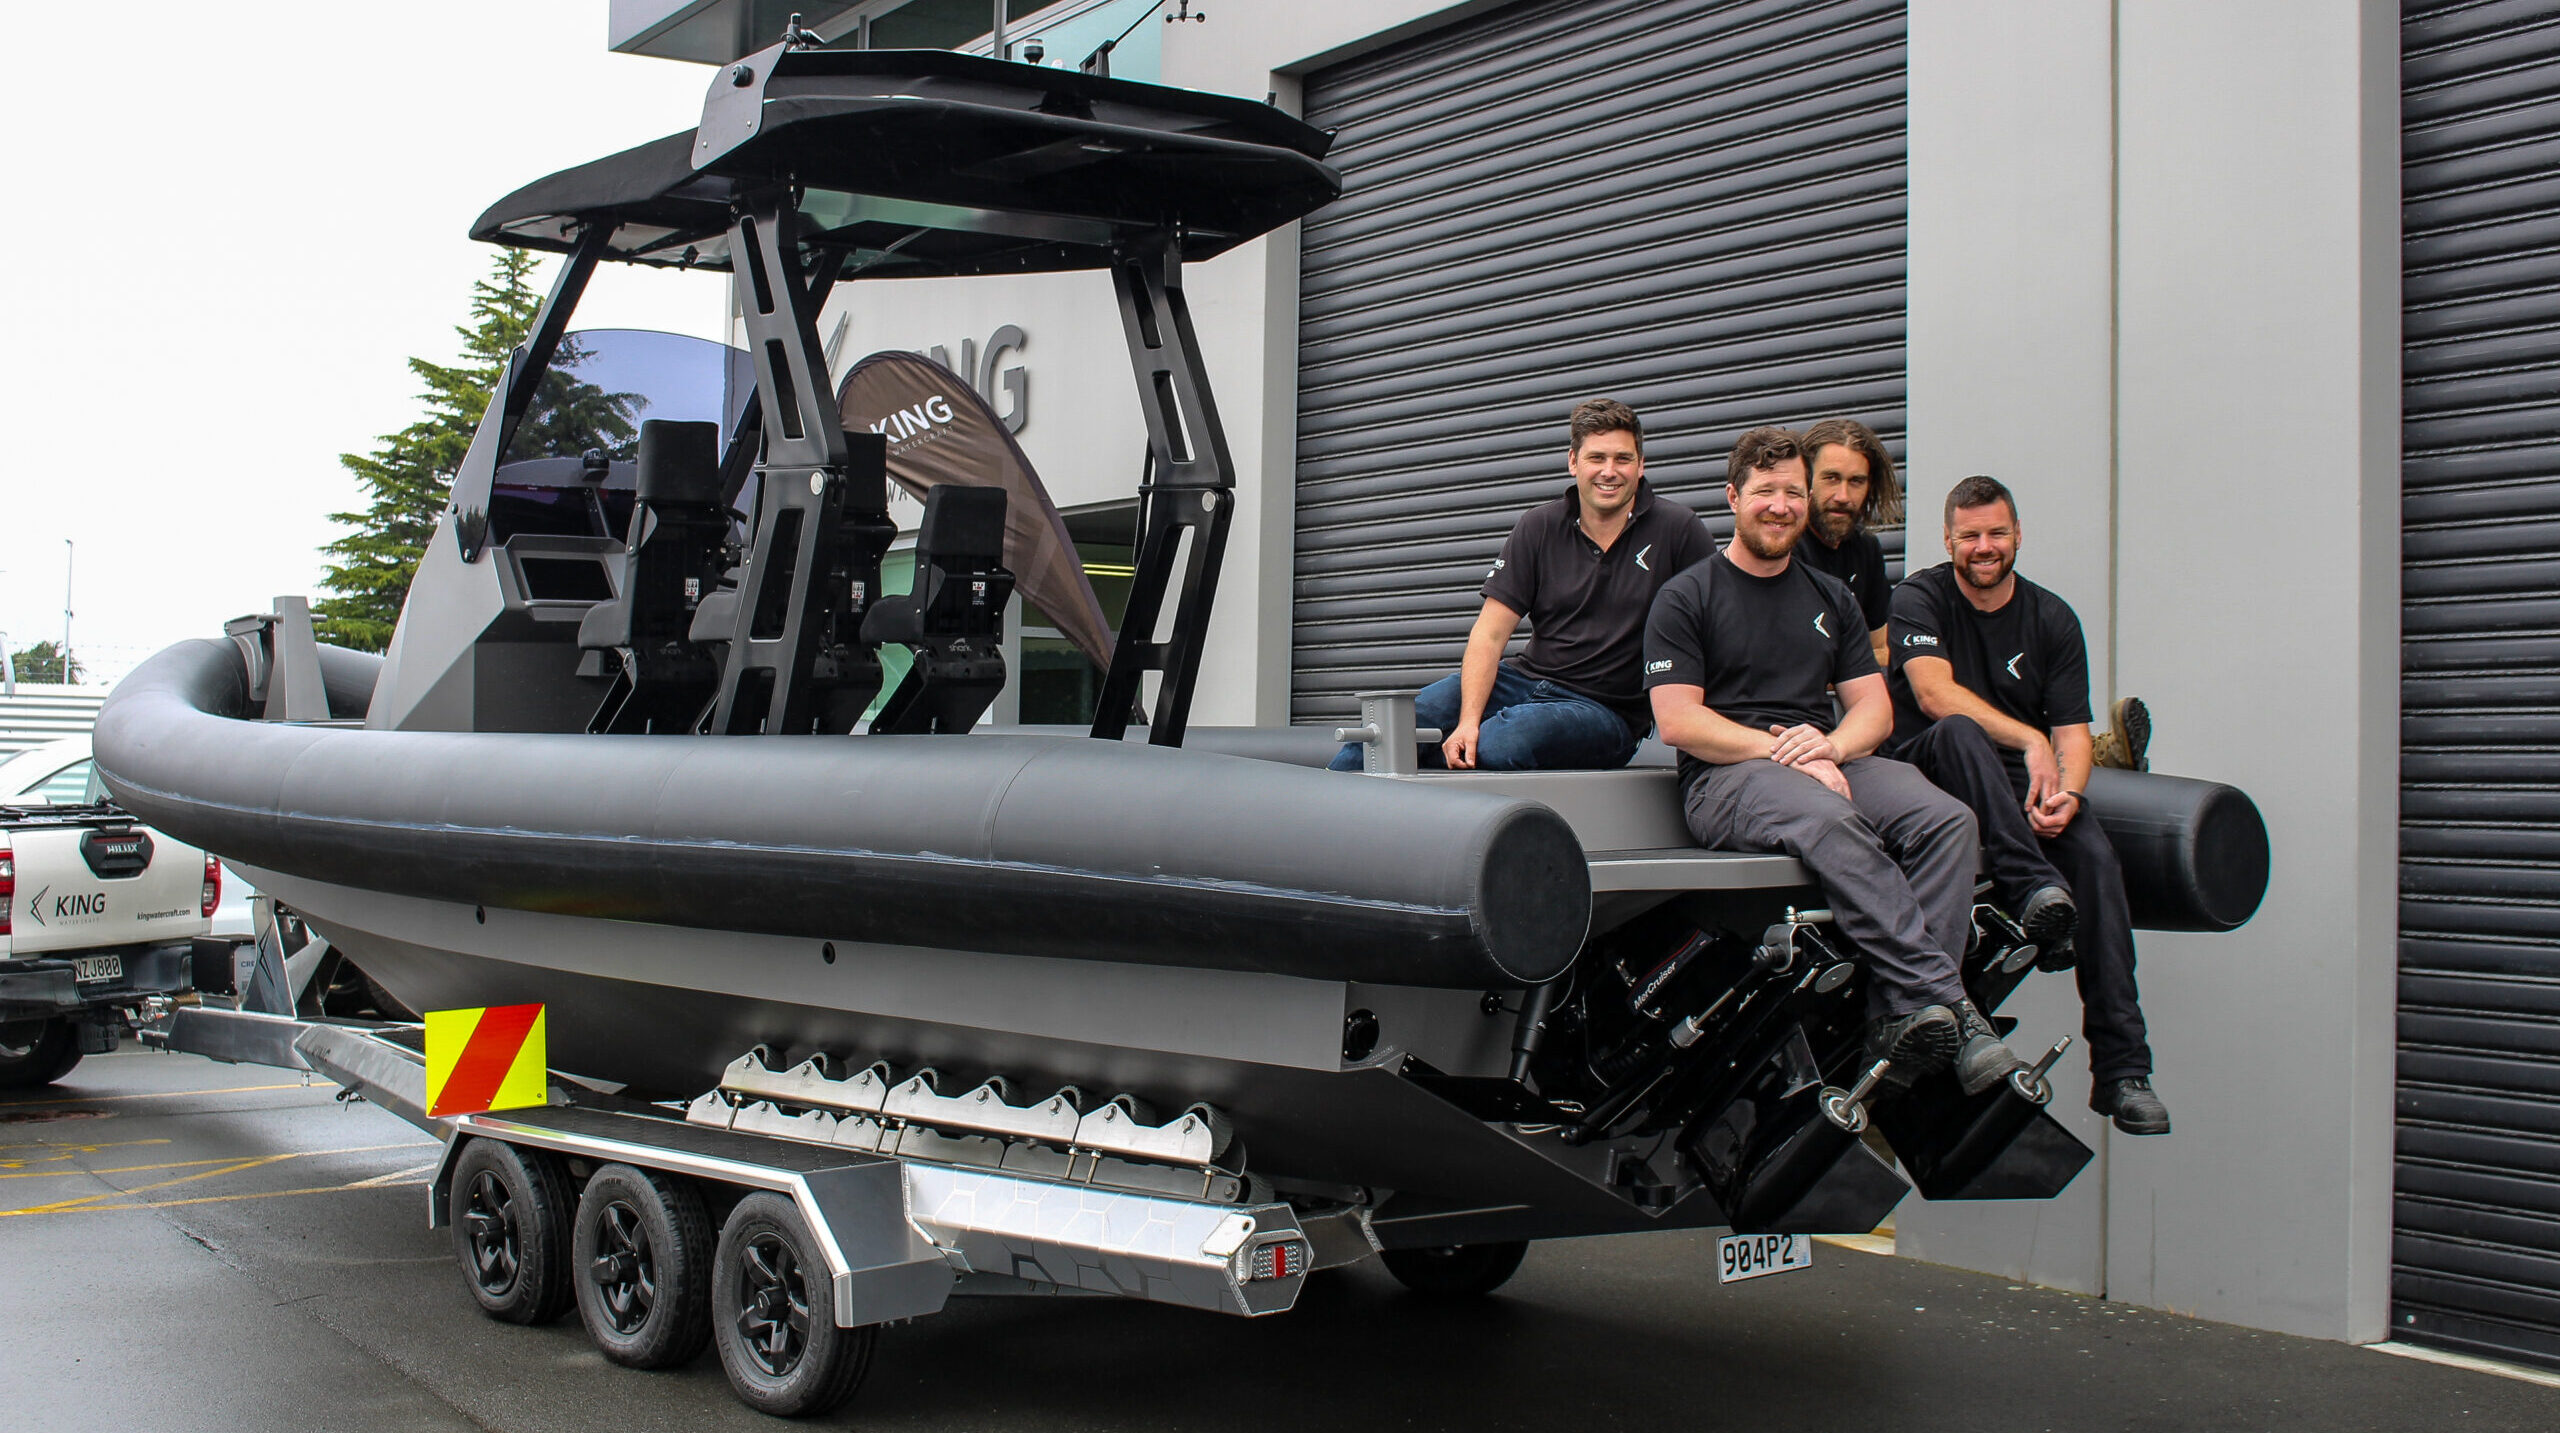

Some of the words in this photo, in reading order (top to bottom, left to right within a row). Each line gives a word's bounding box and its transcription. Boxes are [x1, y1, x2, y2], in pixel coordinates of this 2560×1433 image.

[869, 395, 954, 444] KING
[1912, 635, 1938, 644] KING
[1650, 660, 1672, 670] KING
[106, 844, 138, 854] HILUX
[55, 893, 106, 917] KING
[137, 909, 191, 922] kingwatercraft.com
[1633, 961, 1677, 1010] MerCruiser
[1723, 1235, 1795, 1276] 904P2
